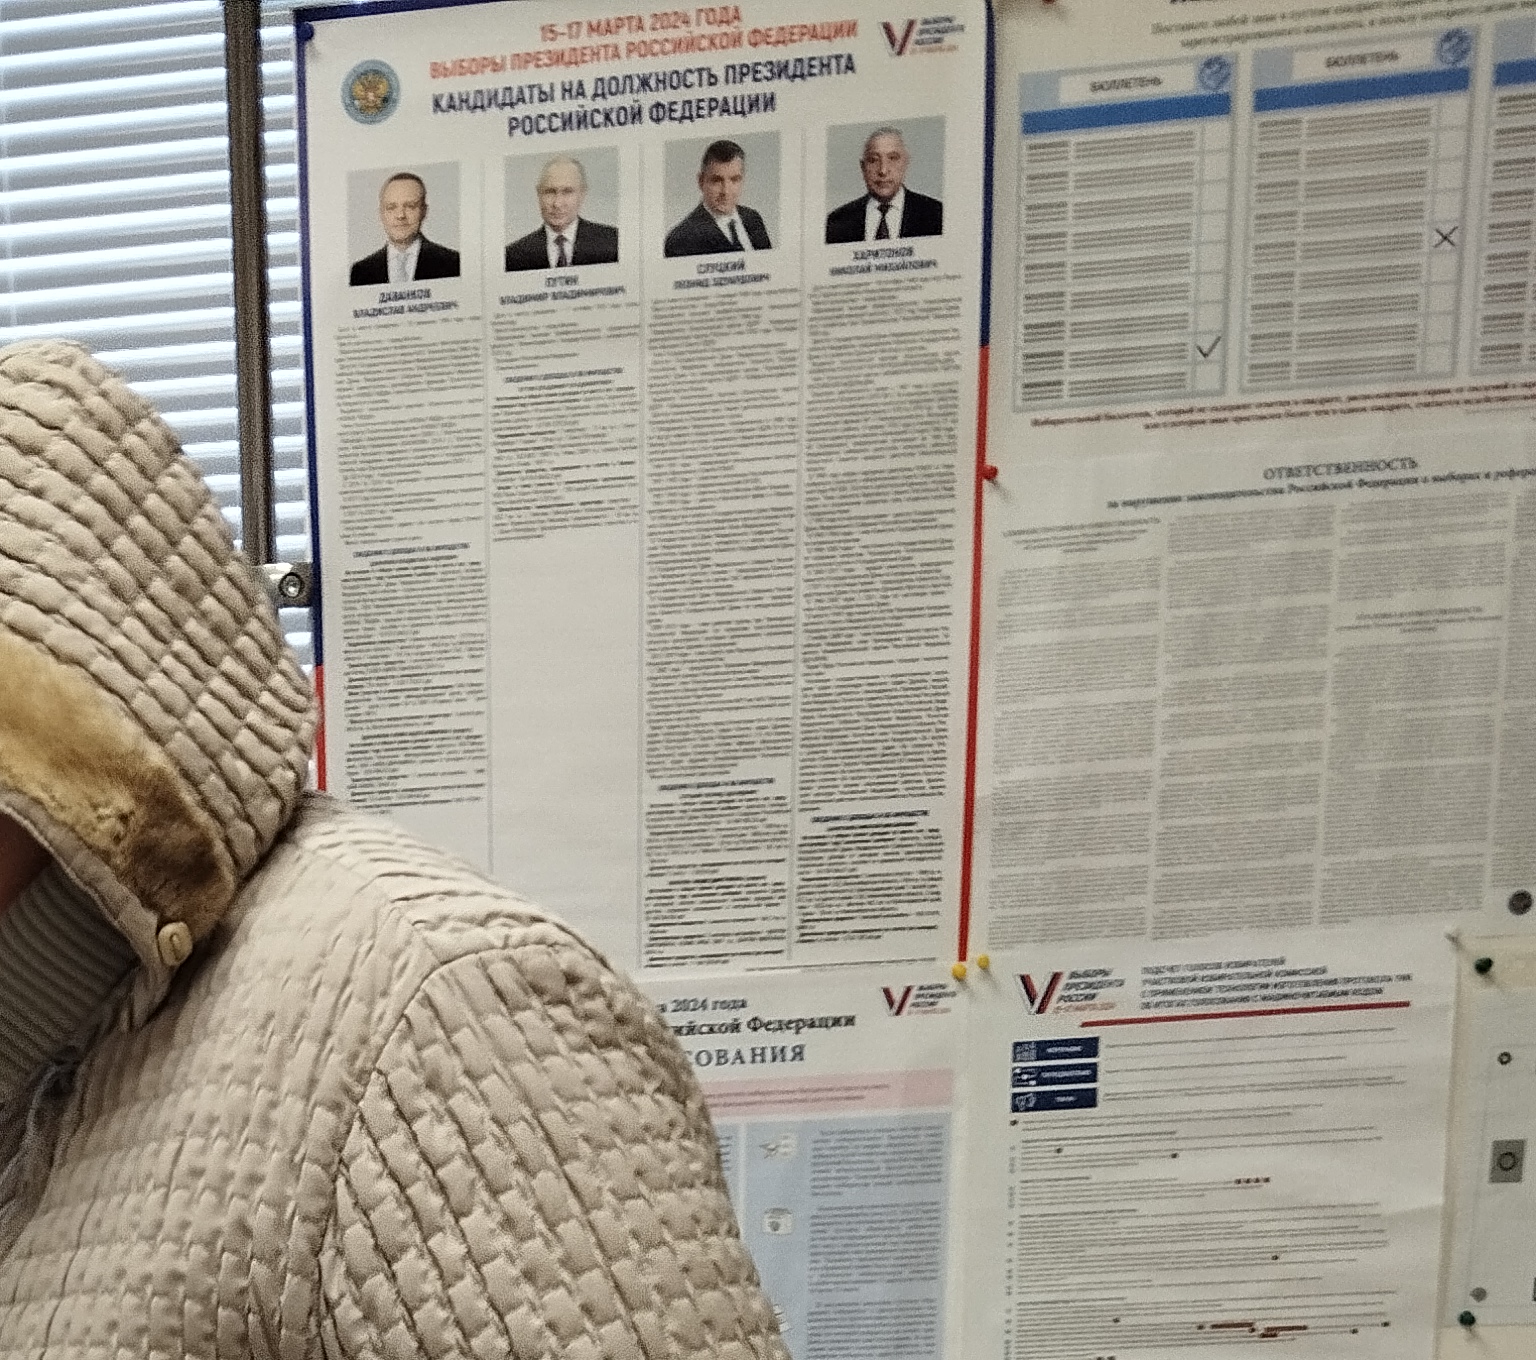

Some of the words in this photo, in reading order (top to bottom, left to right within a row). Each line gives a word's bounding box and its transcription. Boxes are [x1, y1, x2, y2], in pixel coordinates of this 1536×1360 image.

[586, 15, 645, 37] МАРТА
[695, 5, 742, 27] ГОДА
[430, 55, 507, 79] ВЫБОРЫ
[509, 43, 621, 70] ПРЕЗИДЕНТА
[626, 28, 743, 58] РОССИЙСКОЙ
[747, 19, 858, 48] ФЕДЕРАЦИИ
[432, 82, 555, 114] КАНДИДАТЫ
[560, 79, 586, 99] НА
[592, 67, 718, 101] ДОЛЖНОСТЬ
[724, 53, 856, 83] ПРЕЗИДЕНТА
[508, 99, 644, 137] РОССИЙСКОЙ
[648, 92, 777, 124] ФЕДЕРАЦИИ
[1263, 457, 1418, 479] ОТВЕТСТВЕННОСТЬ
[670, 998, 707, 1012] 2024
[711, 999, 747, 1011] года
[747, 1015, 856, 1035] Федерации
[686, 1044, 806, 1067] ОВАНИЯ
